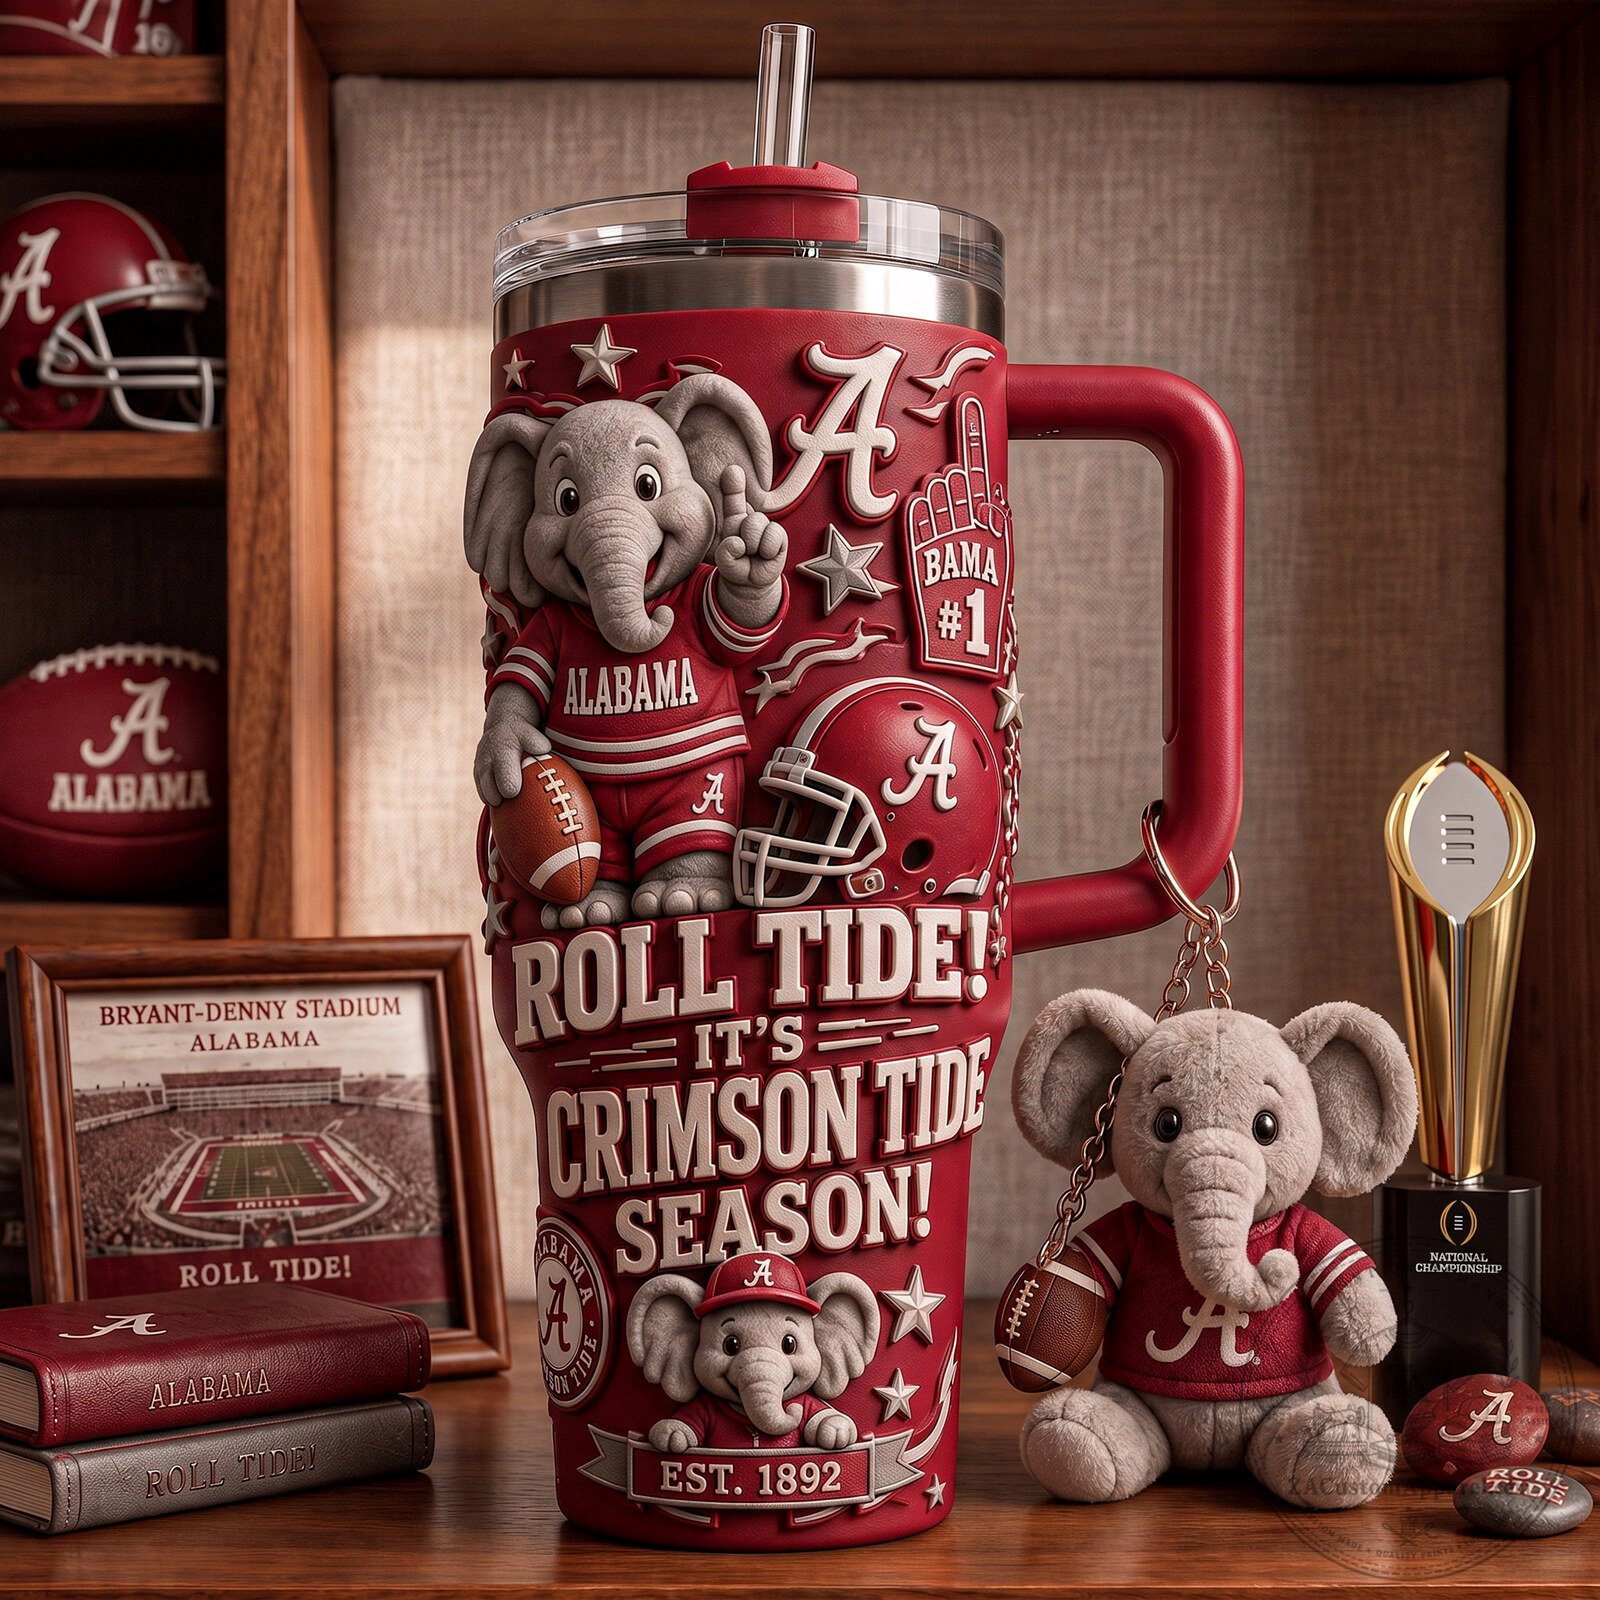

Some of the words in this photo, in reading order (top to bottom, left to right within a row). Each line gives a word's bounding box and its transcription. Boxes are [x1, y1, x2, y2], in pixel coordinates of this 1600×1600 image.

[923, 541, 999, 587] BAMA
[937, 588, 990, 657] #1
[562, 657, 699, 717] ALABAMA
[48, 769, 213, 813] ALABAMA
[511, 918, 735, 1047] ROLL
[756, 908, 991, 1006] TIDE!
[100, 999, 287, 1026] BRYANT-DENNY
[296, 996, 402, 1019] STADIUM
[191, 1030, 320, 1052] ALABAMA
[694, 1015, 804, 1070] IT'S
[547, 1065, 863, 1199] CRIMSON
[874, 1036, 992, 1153] TIDE
[616, 1158, 933, 1274] SEASON!
[179, 1262, 259, 1288] ROLL
[270, 1255, 351, 1282] TIDE!
[1415, 1263, 1502, 1274] CHAMPIONSHIP
[1430, 1251, 1488, 1263] NATIONAL
[570, 1334, 598, 1388] TIDE
[148, 1368, 272, 1410] ALABAMA
[146, 1458, 225, 1498] ROLL
[237, 1443, 318, 1481] TIDE!
[660, 1461, 743, 1495] EST.
[758, 1460, 842, 1496] 1892
[1486, 1467, 1569, 1490] ROLL
[1486, 1479, 1567, 1506] TIDE
